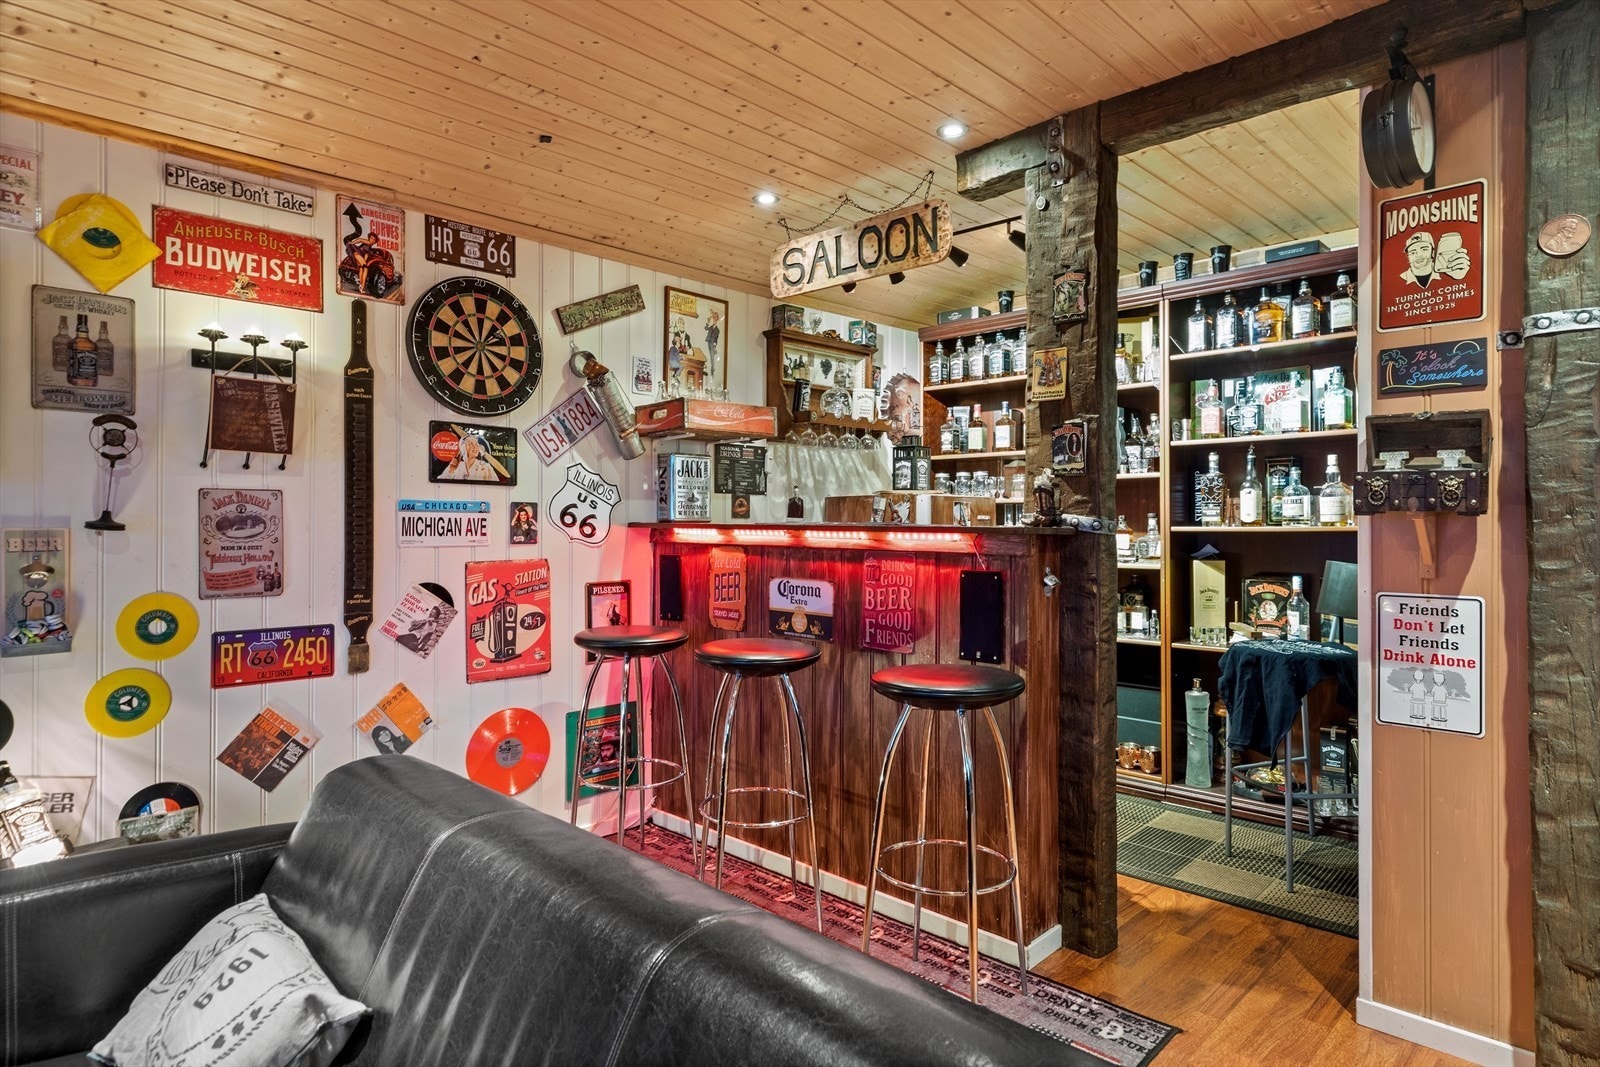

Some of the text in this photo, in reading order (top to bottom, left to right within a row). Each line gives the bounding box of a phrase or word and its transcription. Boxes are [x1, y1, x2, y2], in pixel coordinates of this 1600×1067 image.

[174, 167, 307, 212] Please Don't Take
[361, 208, 400, 224] DANGEROUS
[1386, 193, 1478, 239] MOONSHINE
[370, 220, 399, 240] CURVES
[448, 221, 470, 232] HISTORIC
[472, 227, 487, 236] ROUTE
[174, 221, 304, 259] ANHEUSER-BUSCH
[377, 240, 399, 251] AHEAD
[431, 225, 510, 266] HR 66
[782, 206, 939, 287] SALOON
[165, 236, 311, 286] BUDWEISER
[1387, 289, 1475, 313] INTO GOOD TIMES
[1395, 283, 1467, 303] TURNIN' CORN
[1405, 302, 1456, 317] SINCE 1928
[1399, 356, 1461, 375] 5 o'clock
[1411, 350, 1437, 363] It's
[1406, 364, 1484, 385] Somewhere
[532, 396, 600, 458] USA 1884
[677, 460, 703, 478] JACK
[573, 470, 614, 501] ILLINOIS
[212, 493, 234, 510] JACK
[424, 502, 468, 510] CHICAGO
[577, 492, 598, 509] US
[401, 516, 487, 537] MICHIGAN AVE
[560, 503, 597, 538] 66
[7, 537, 62, 552] BEER
[881, 560, 905, 572] DRINK
[514, 567, 548, 586] STATION
[880, 573, 913, 588] GOOD
[468, 578, 498, 606] GAS
[593, 586, 624, 594] PILSENER
[714, 572, 741, 603] BEER
[777, 579, 821, 599] Corona
[790, 596, 807, 606] Extra
[864, 586, 912, 611] BEER
[1399, 603, 1459, 618] Friends
[472, 622, 484, 633] FULL
[878, 611, 911, 631] GOOD
[1393, 618, 1465, 635] Don't Let
[217, 635, 225, 644] 19
[260, 631, 291, 641] ILLINOIS
[322, 628, 330, 636] 26
[865, 618, 913, 648] FRIENDS
[1399, 635, 1459, 651] Friends
[220, 636, 327, 674] RT 66 2450
[1383, 649, 1476, 669] Drink Alone
[257, 668, 294, 679] CALIFORNIA
[193, 947, 269, 1010] 1929
[1033, 989, 1103, 1020] DENIM
